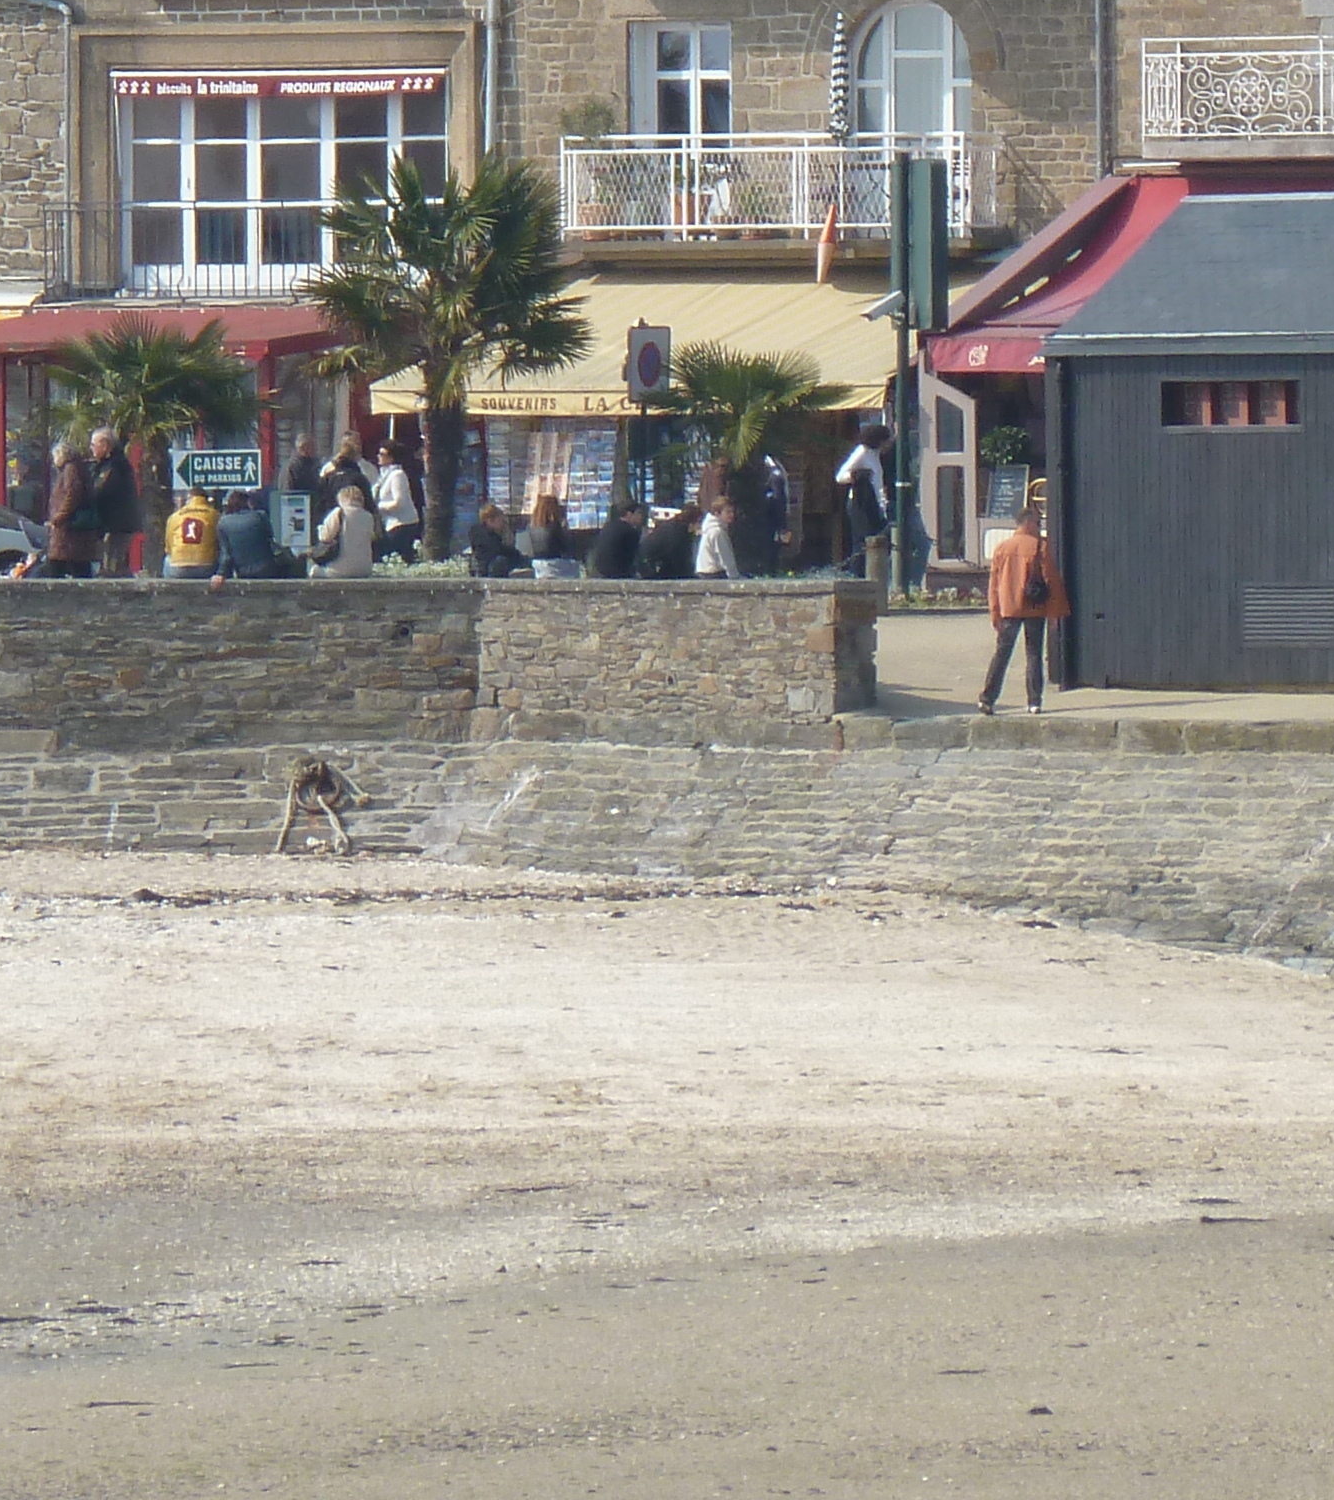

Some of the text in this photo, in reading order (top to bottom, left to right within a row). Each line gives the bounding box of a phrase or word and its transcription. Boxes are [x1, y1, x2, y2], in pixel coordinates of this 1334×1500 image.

[157, 78, 396, 95] biscuits la trinitaine PRODUITS REGIONAUX
[481, 396, 557, 411] SOUVENIRS
[583, 396, 610, 411] LA
[193, 456, 242, 471] CAISSE
[208, 473, 242, 483] PARKING
